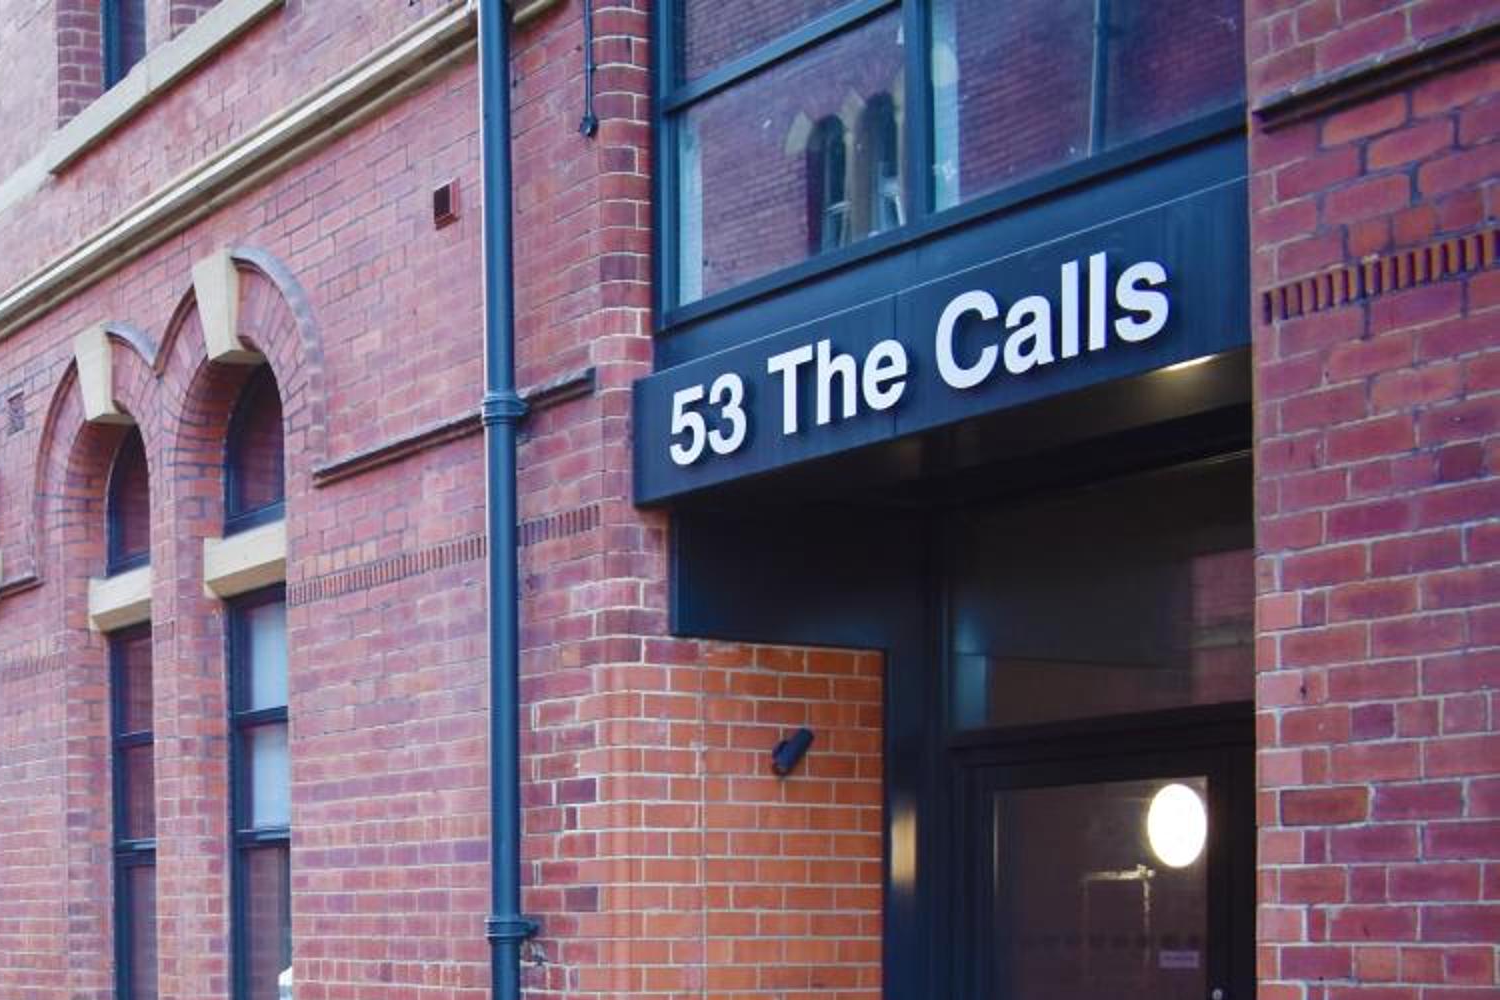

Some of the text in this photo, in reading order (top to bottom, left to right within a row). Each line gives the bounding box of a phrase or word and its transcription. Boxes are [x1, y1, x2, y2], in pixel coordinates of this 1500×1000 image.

[669, 252, 1170, 465] 53 The Calls
